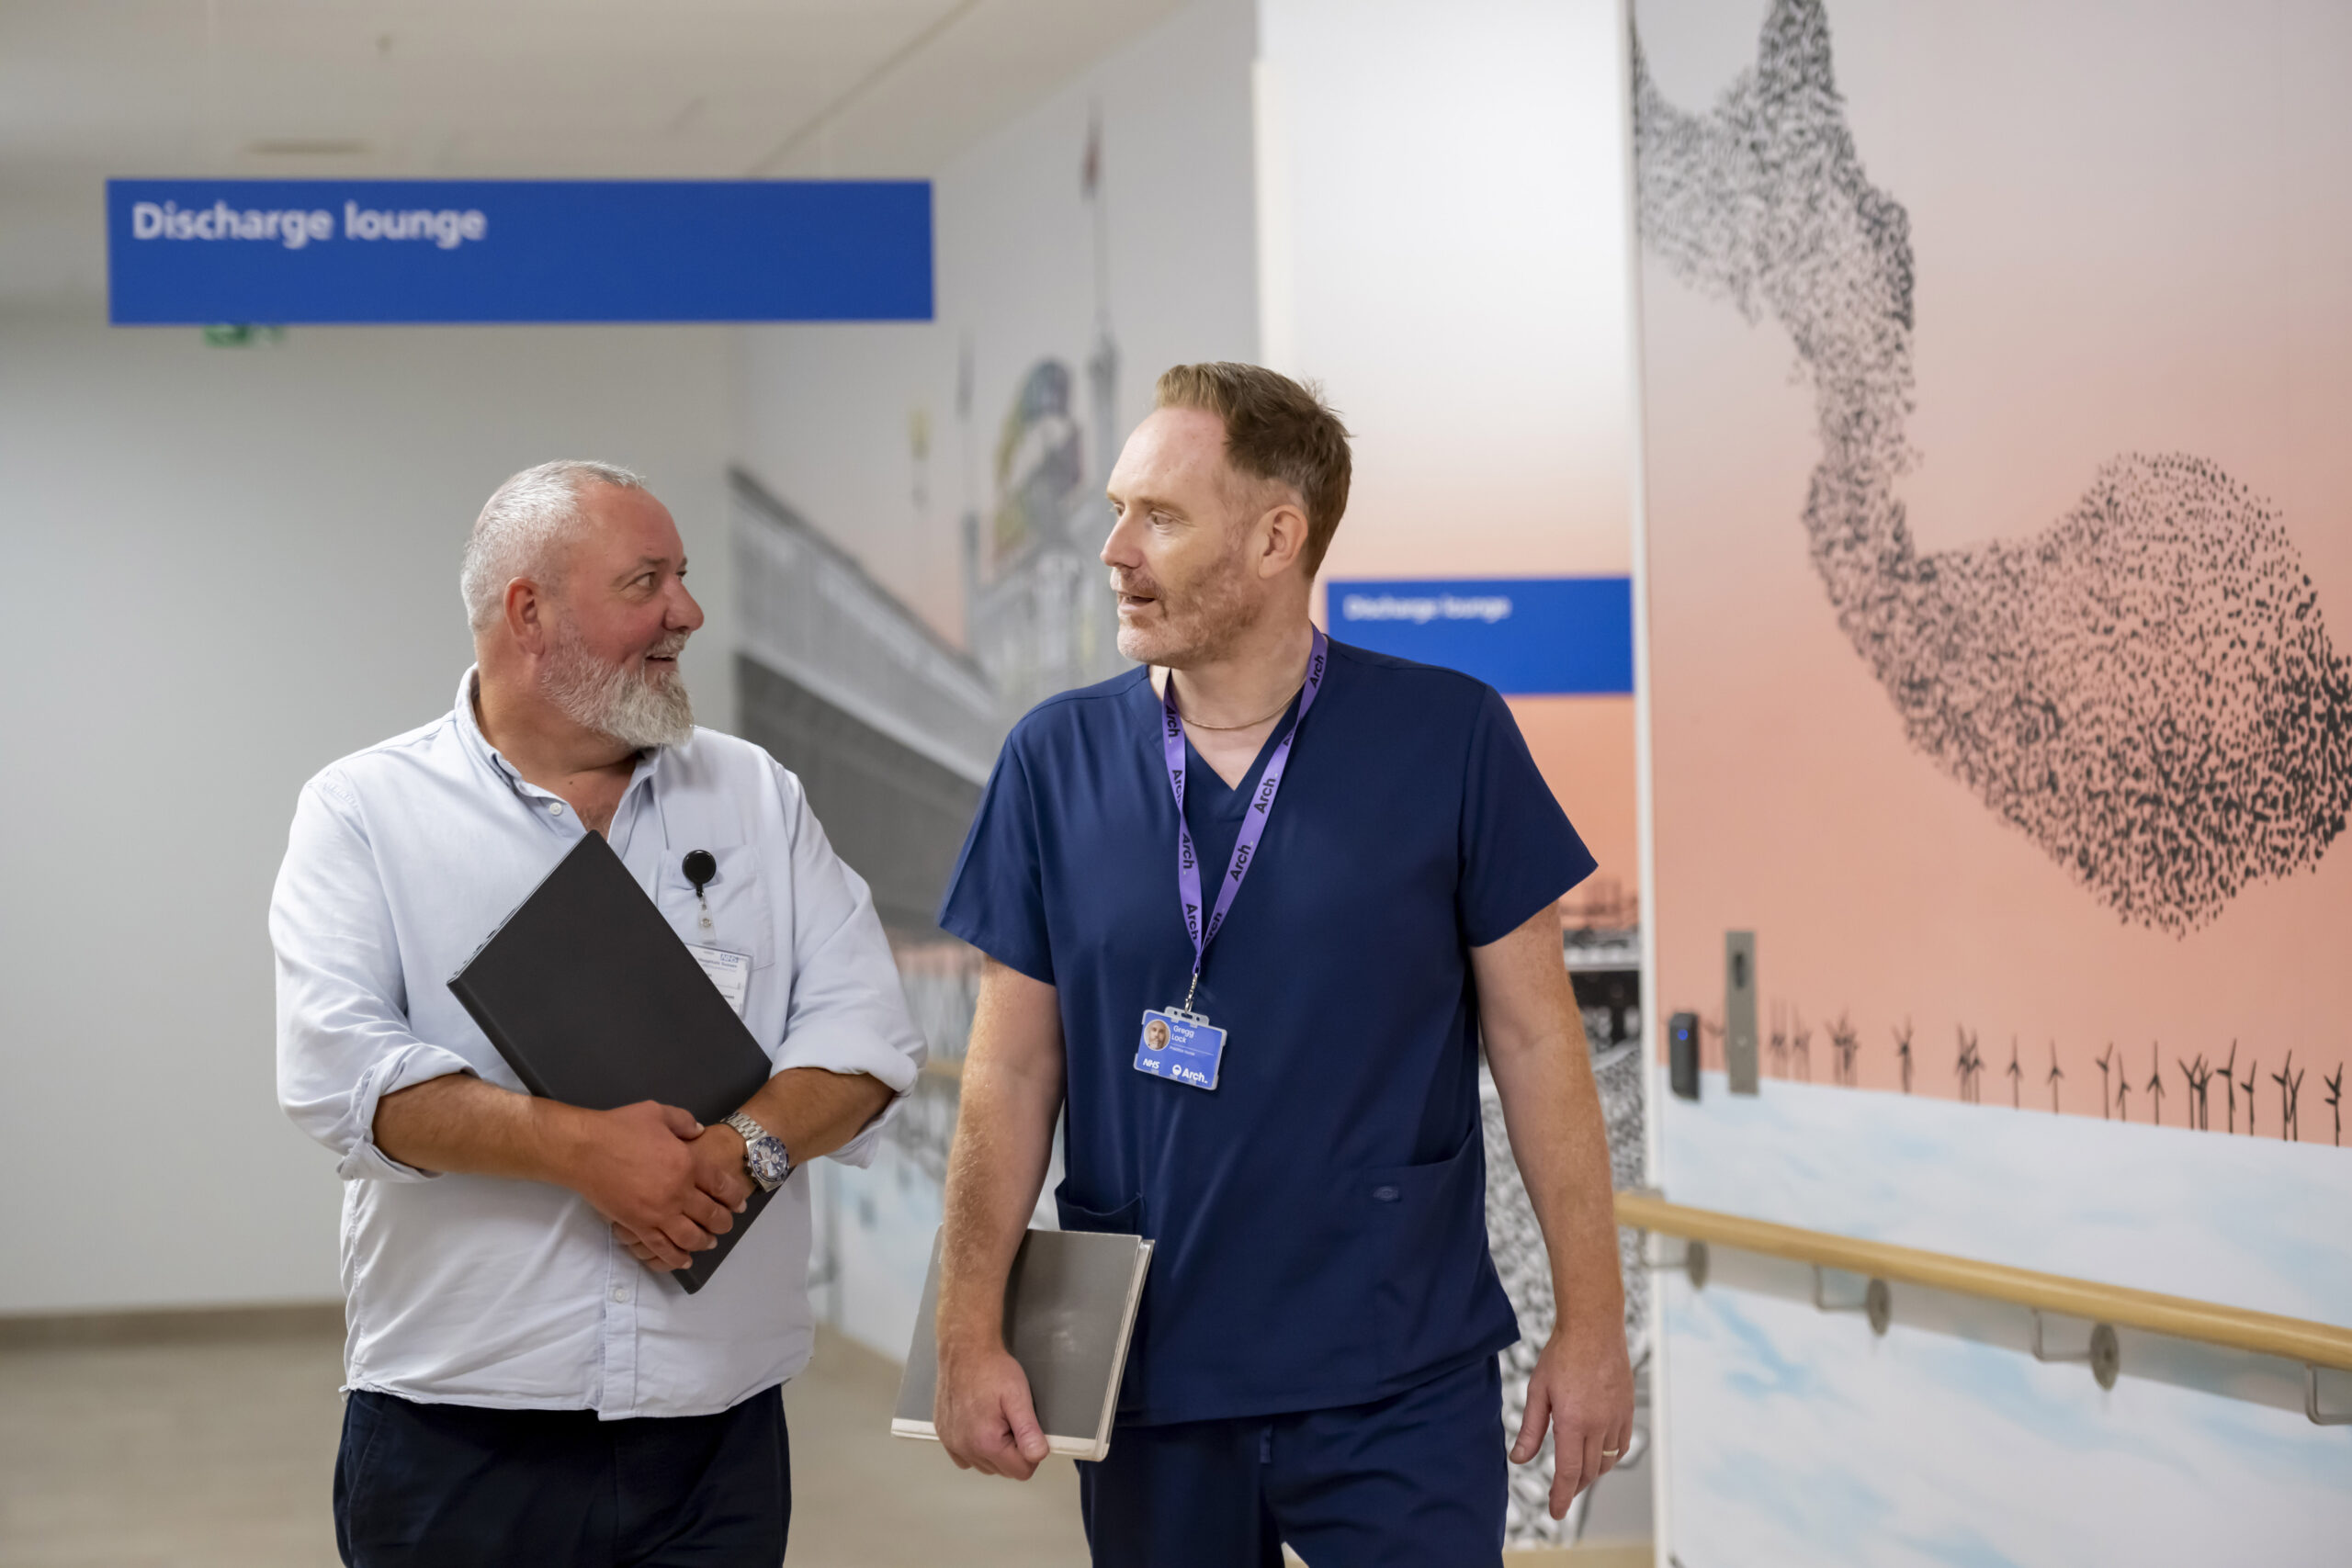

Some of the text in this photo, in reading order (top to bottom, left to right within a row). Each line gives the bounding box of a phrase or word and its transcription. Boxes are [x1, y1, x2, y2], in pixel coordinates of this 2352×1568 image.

[132, 200, 487, 249] Discharge lounge
[1143, 1058, 1160, 1069] NHS
[1182, 1067, 1208, 1084] Arch.
